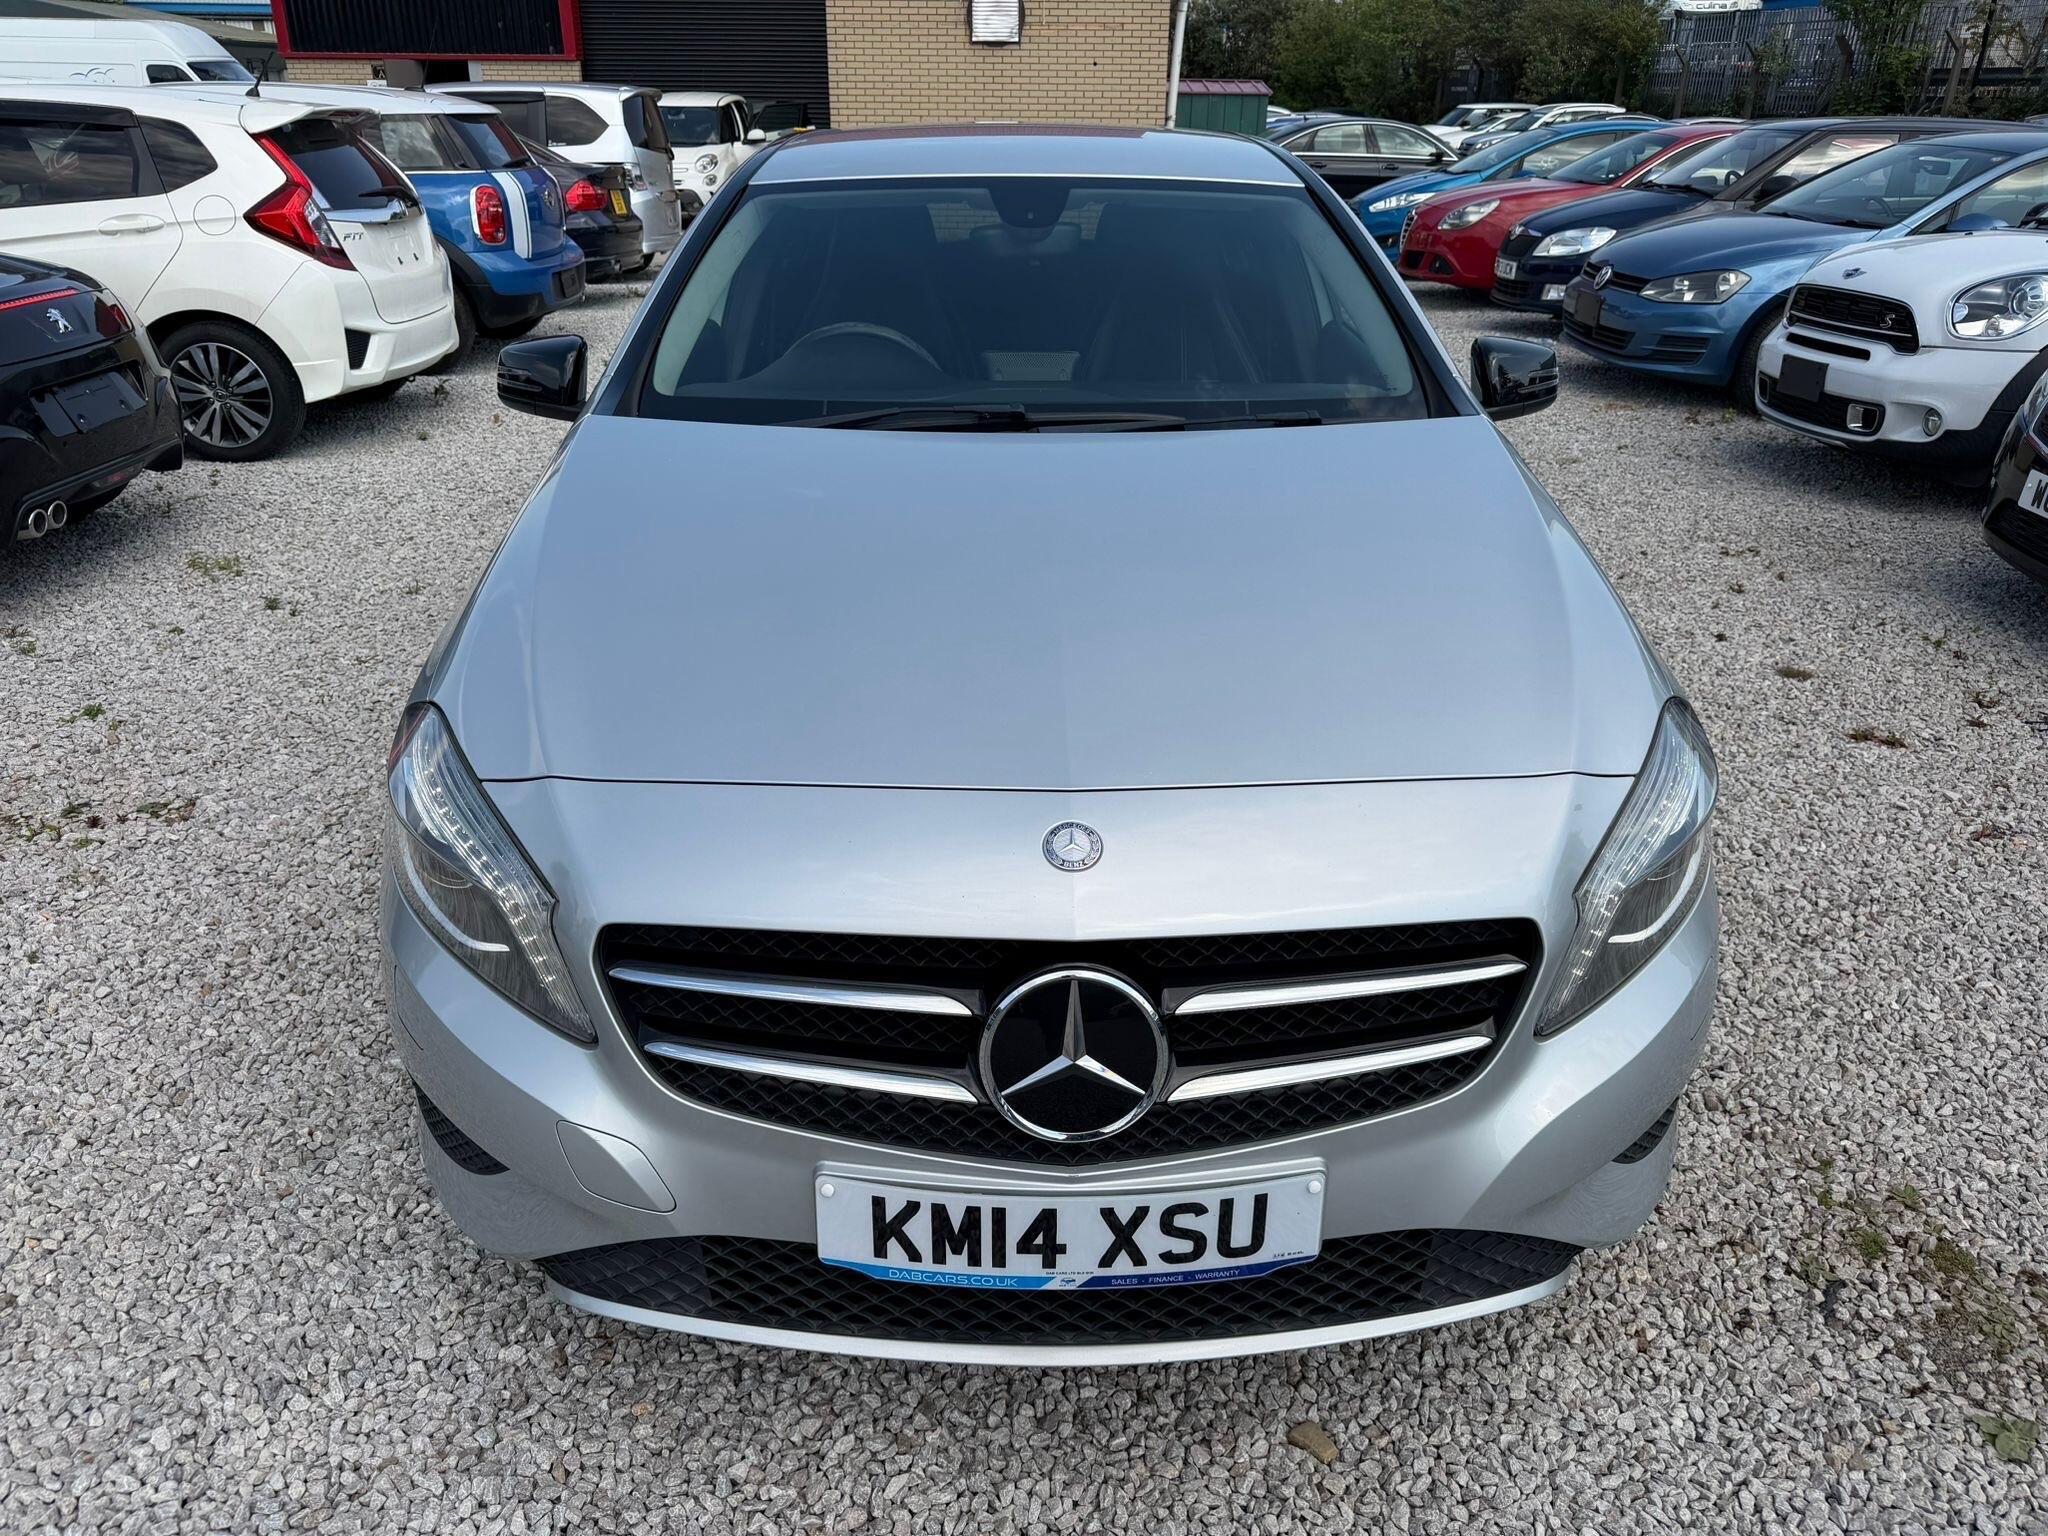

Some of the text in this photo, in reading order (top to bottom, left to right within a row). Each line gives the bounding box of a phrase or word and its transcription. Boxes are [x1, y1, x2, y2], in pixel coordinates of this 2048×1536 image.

[872, 1193, 1268, 1269] KM14 XSU
[1111, 1278, 1138, 1286] SALES
[1148, 1275, 1184, 1284] FINANCE
[1194, 1269, 1241, 1280] WARRANTY
